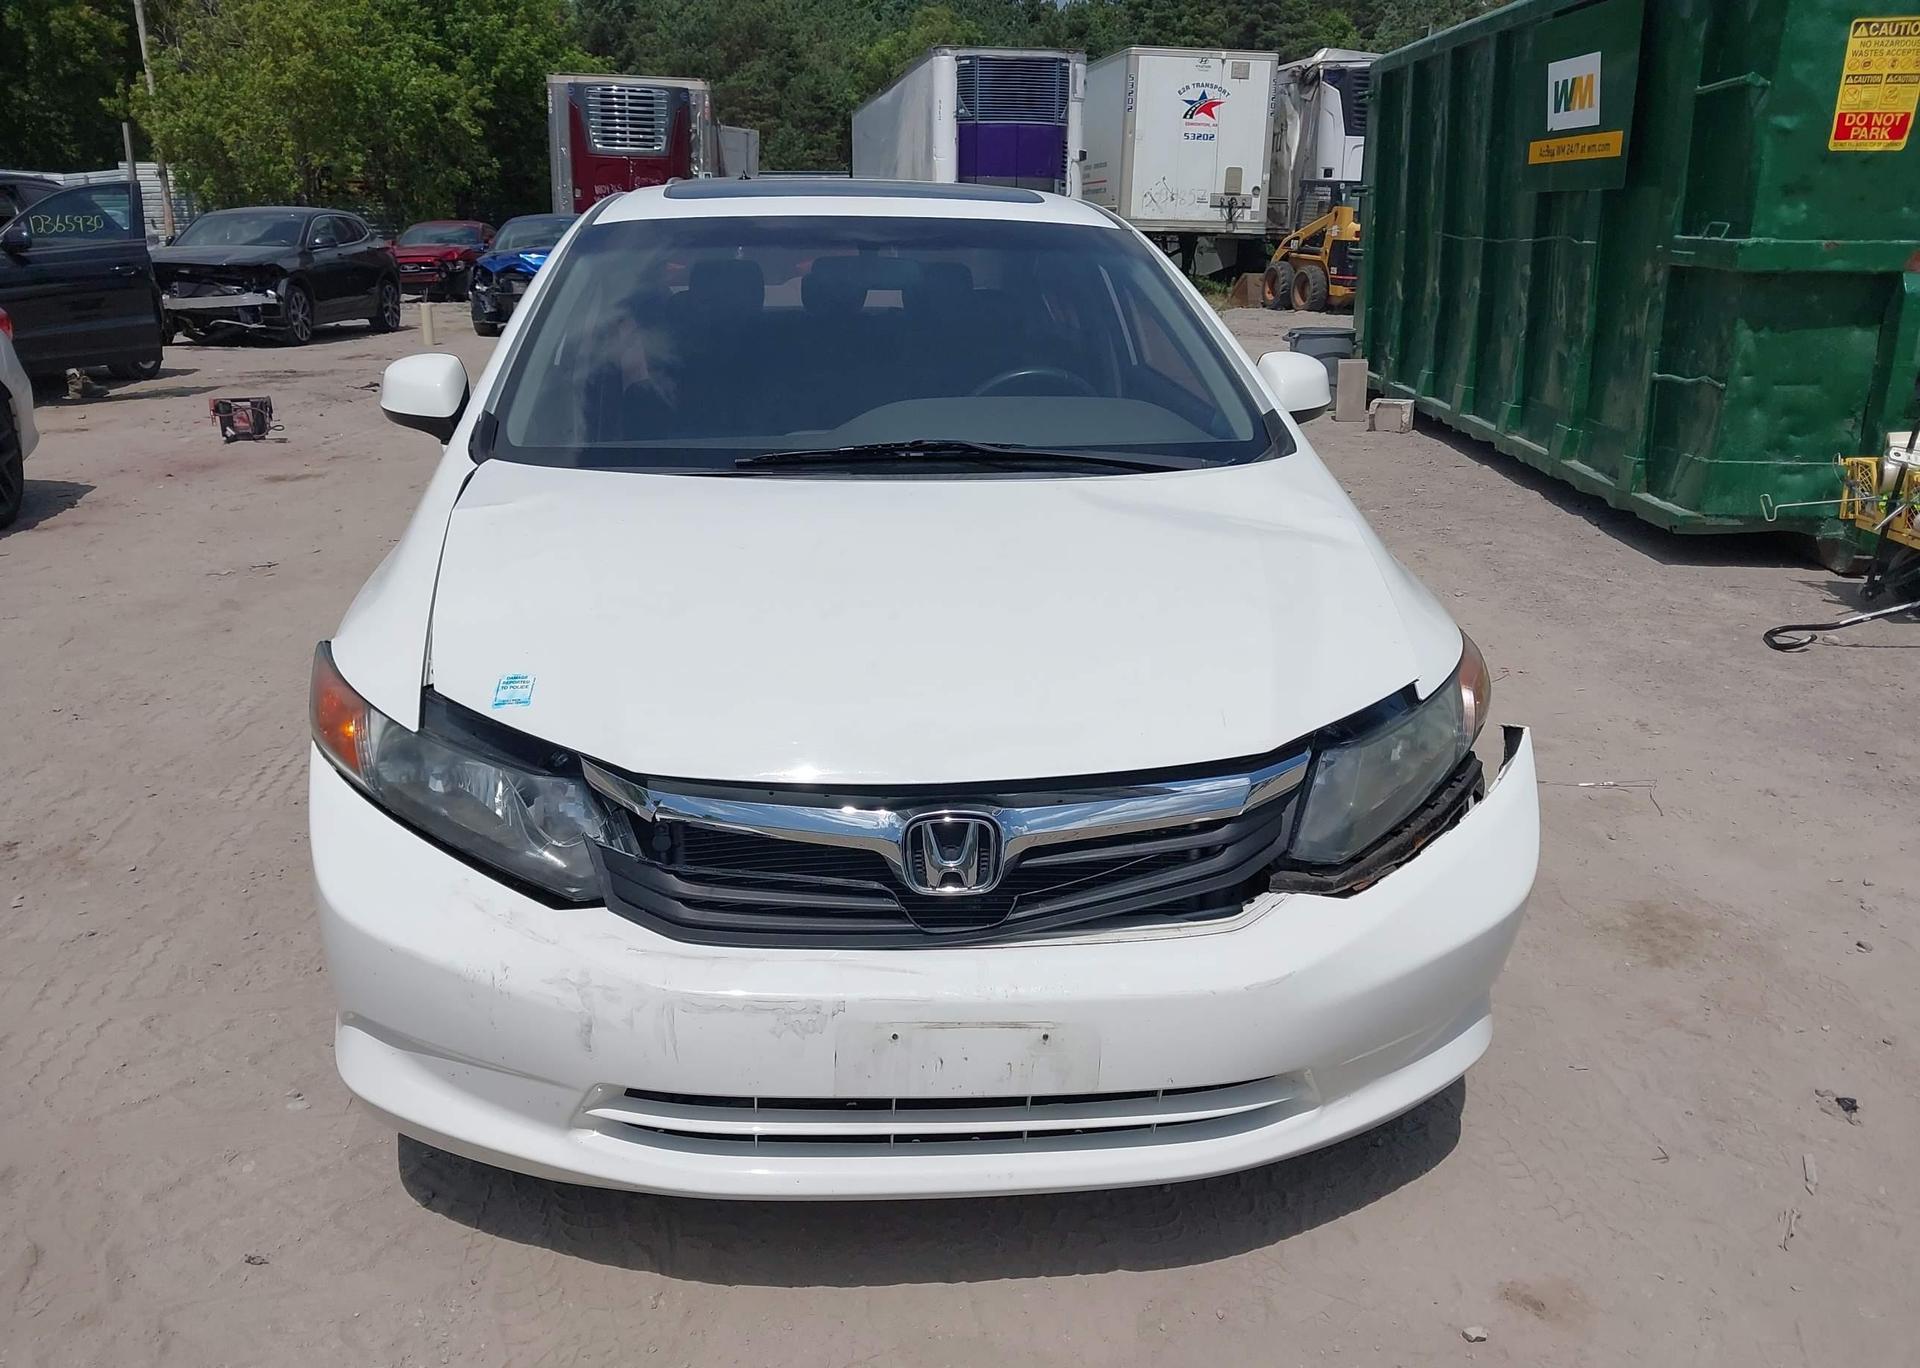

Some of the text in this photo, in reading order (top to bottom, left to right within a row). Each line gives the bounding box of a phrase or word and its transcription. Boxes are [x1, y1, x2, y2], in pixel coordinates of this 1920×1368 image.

[1860, 40, 1872, 48] NO
[1851, 49, 1884, 57] WASTES
[1192, 82, 1231, 98] TRANSPORT
[1553, 73, 1594, 114] WM
[1844, 113, 1905, 126] DO NOT
[1183, 132, 1215, 141] 53202
[1850, 127, 1892, 139] PARK
